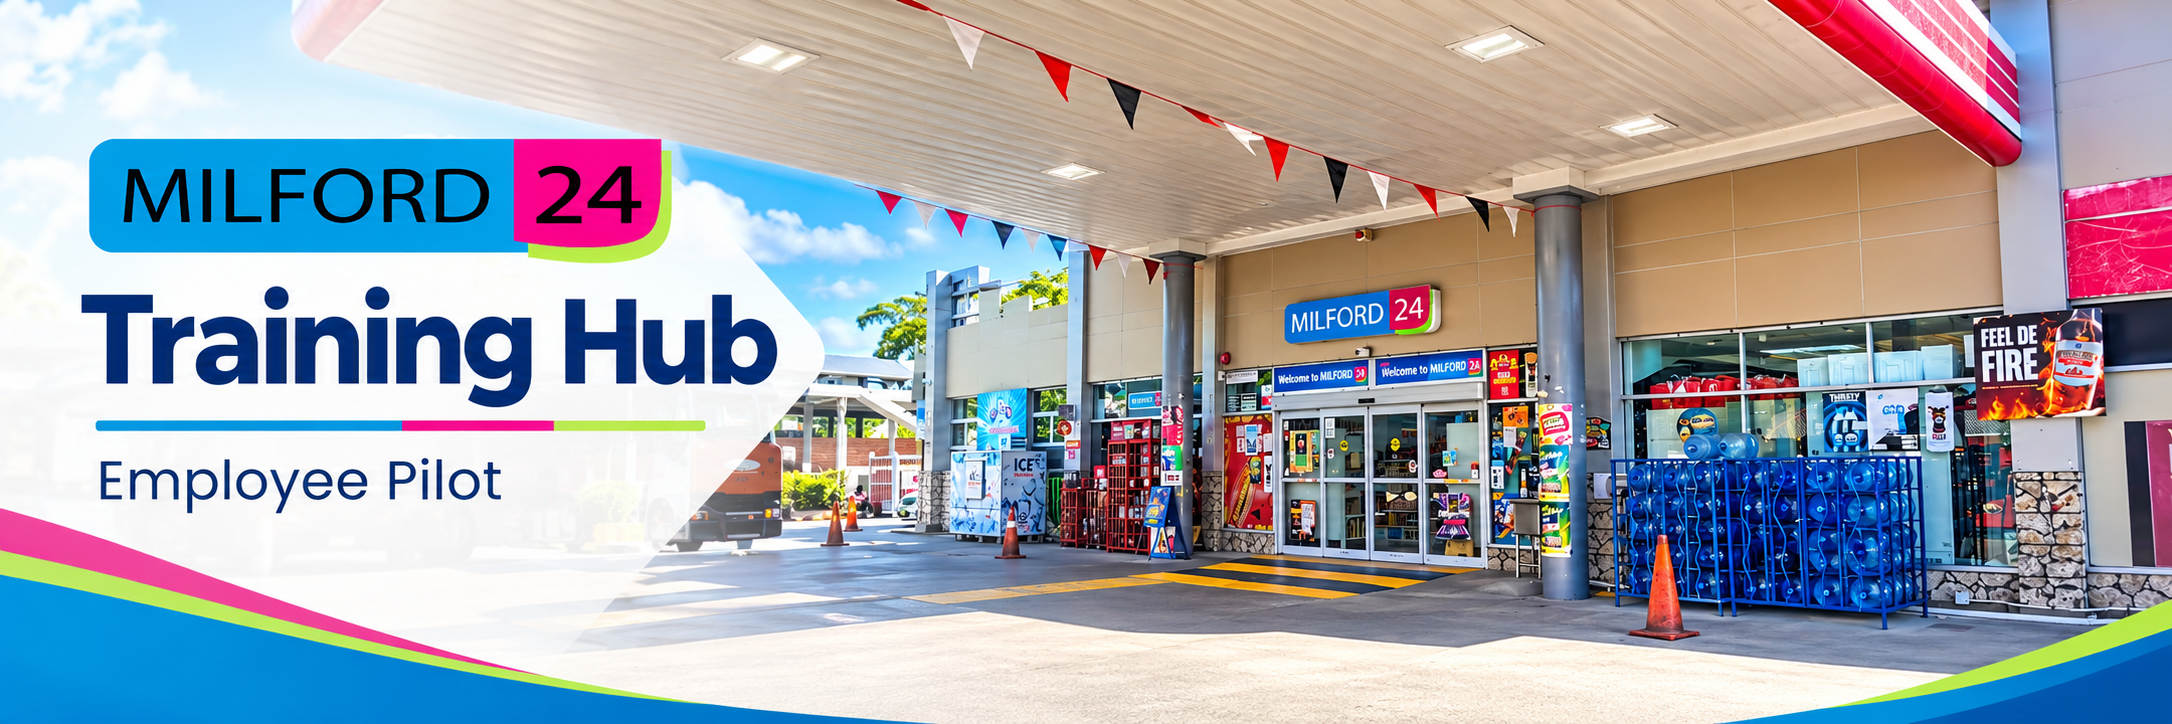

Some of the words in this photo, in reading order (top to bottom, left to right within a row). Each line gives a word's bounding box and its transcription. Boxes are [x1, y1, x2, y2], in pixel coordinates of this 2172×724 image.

[1291, 302, 1384, 333] MILFORD
[1394, 296, 1424, 322] 24
[1981, 326, 2014, 348] FEEL
[2017, 325, 2038, 345] DE
[1382, 367, 1418, 377] Welcome
[1420, 365, 1428, 374] to
[1430, 361, 1466, 373] MILFORD
[1981, 347, 2039, 383] FIRE
[1278, 374, 1309, 384] Welcome
[1311, 373, 1319, 382] to
[1320, 370, 1353, 381] MILFORD
